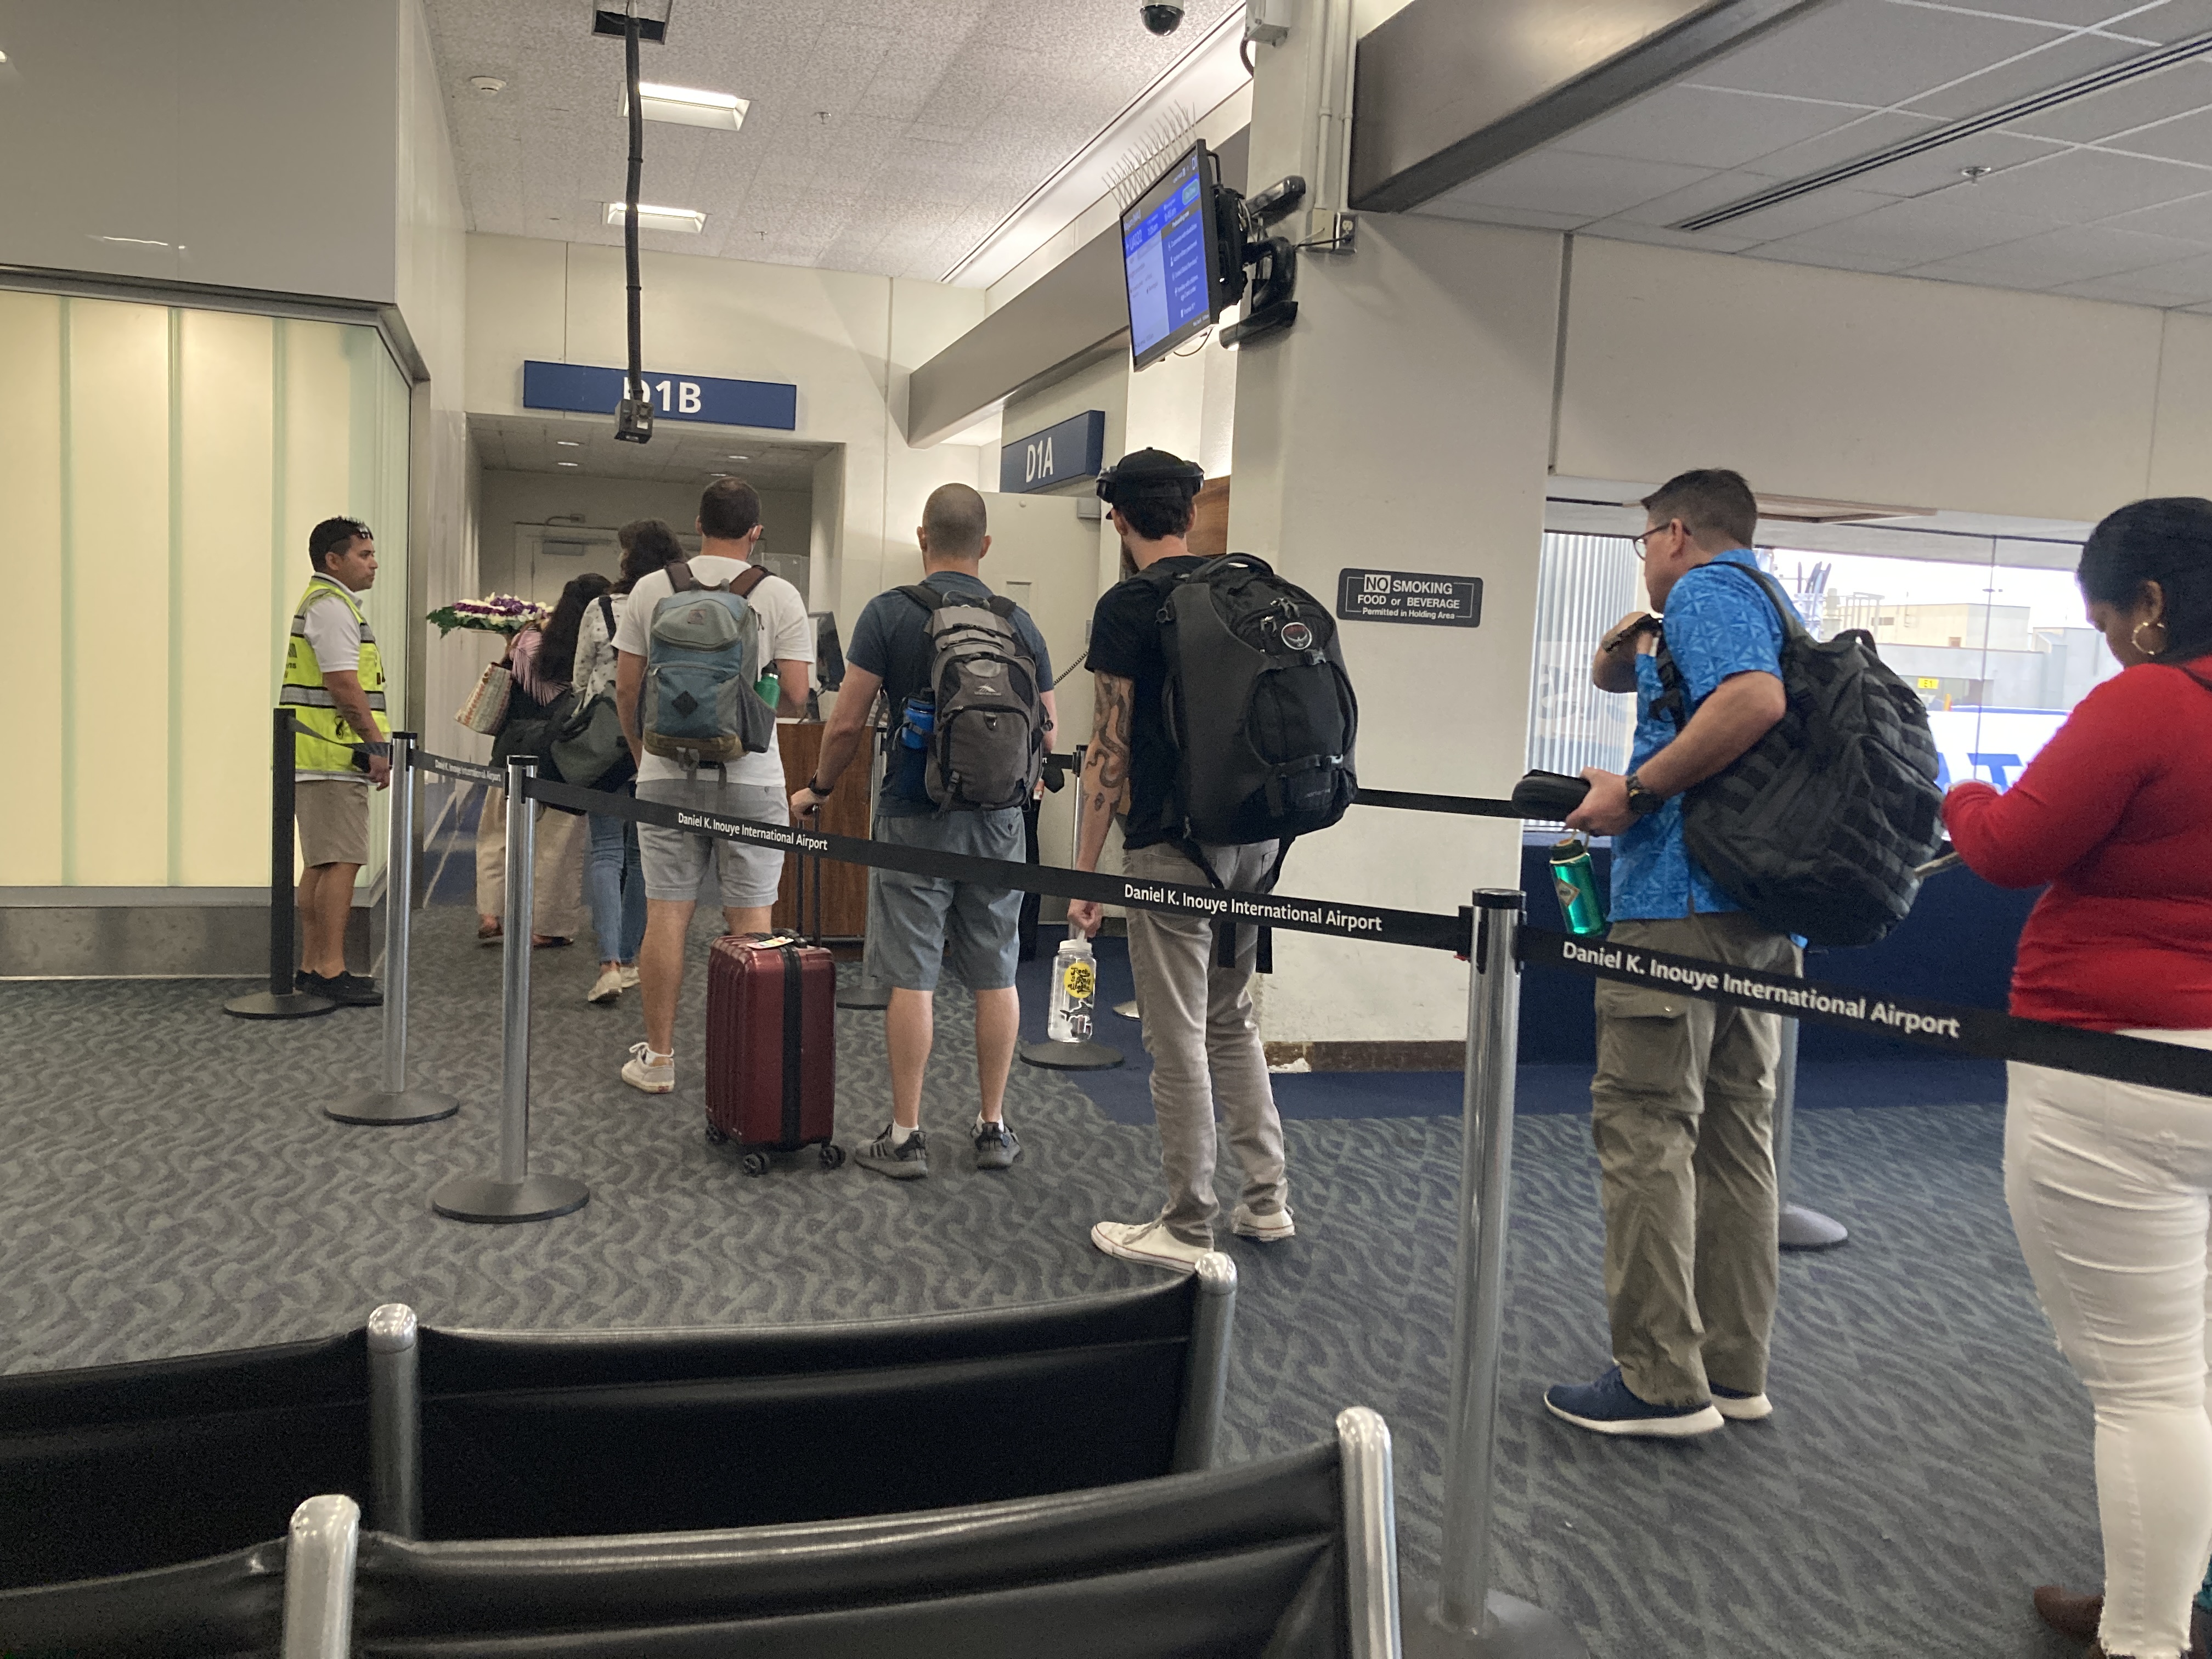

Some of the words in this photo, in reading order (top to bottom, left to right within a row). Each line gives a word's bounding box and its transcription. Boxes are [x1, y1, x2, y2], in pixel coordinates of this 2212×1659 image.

[1025, 437, 1053, 483] D1A
[1357, 594, 1386, 605] FOOD
[1391, 597, 1401, 606] or
[1407, 597, 1460, 609] BEVERAGE
[1365, 577, 1389, 591] NO
[1392, 580, 1453, 594] SMOKING
[1362, 607, 1398, 617] Permitted
[1401, 609, 1407, 617] in
[1409, 610, 1436, 620] Holding
[1438, 611, 1455, 619] Area
[678, 812, 702, 827] Daniel
[704, 820, 712, 830] K.
[713, 821, 740, 837] Inouye
[742, 824, 794, 844] International
[796, 834, 828, 851] Airport
[1124, 884, 1164, 904] Daniel
[1167, 890, 1180, 906] K.
[1182, 893, 1227, 915] Inouye
[1231, 898, 1323, 924] International
[1326, 910, 1383, 932] Airport
[1563, 941, 1622, 970] Daniel
[1626, 955, 1645, 975] K.
[1650, 960, 1718, 990] Inouye
[1723, 973, 1866, 1019] International
[1871, 1002, 1960, 1039] Airport
